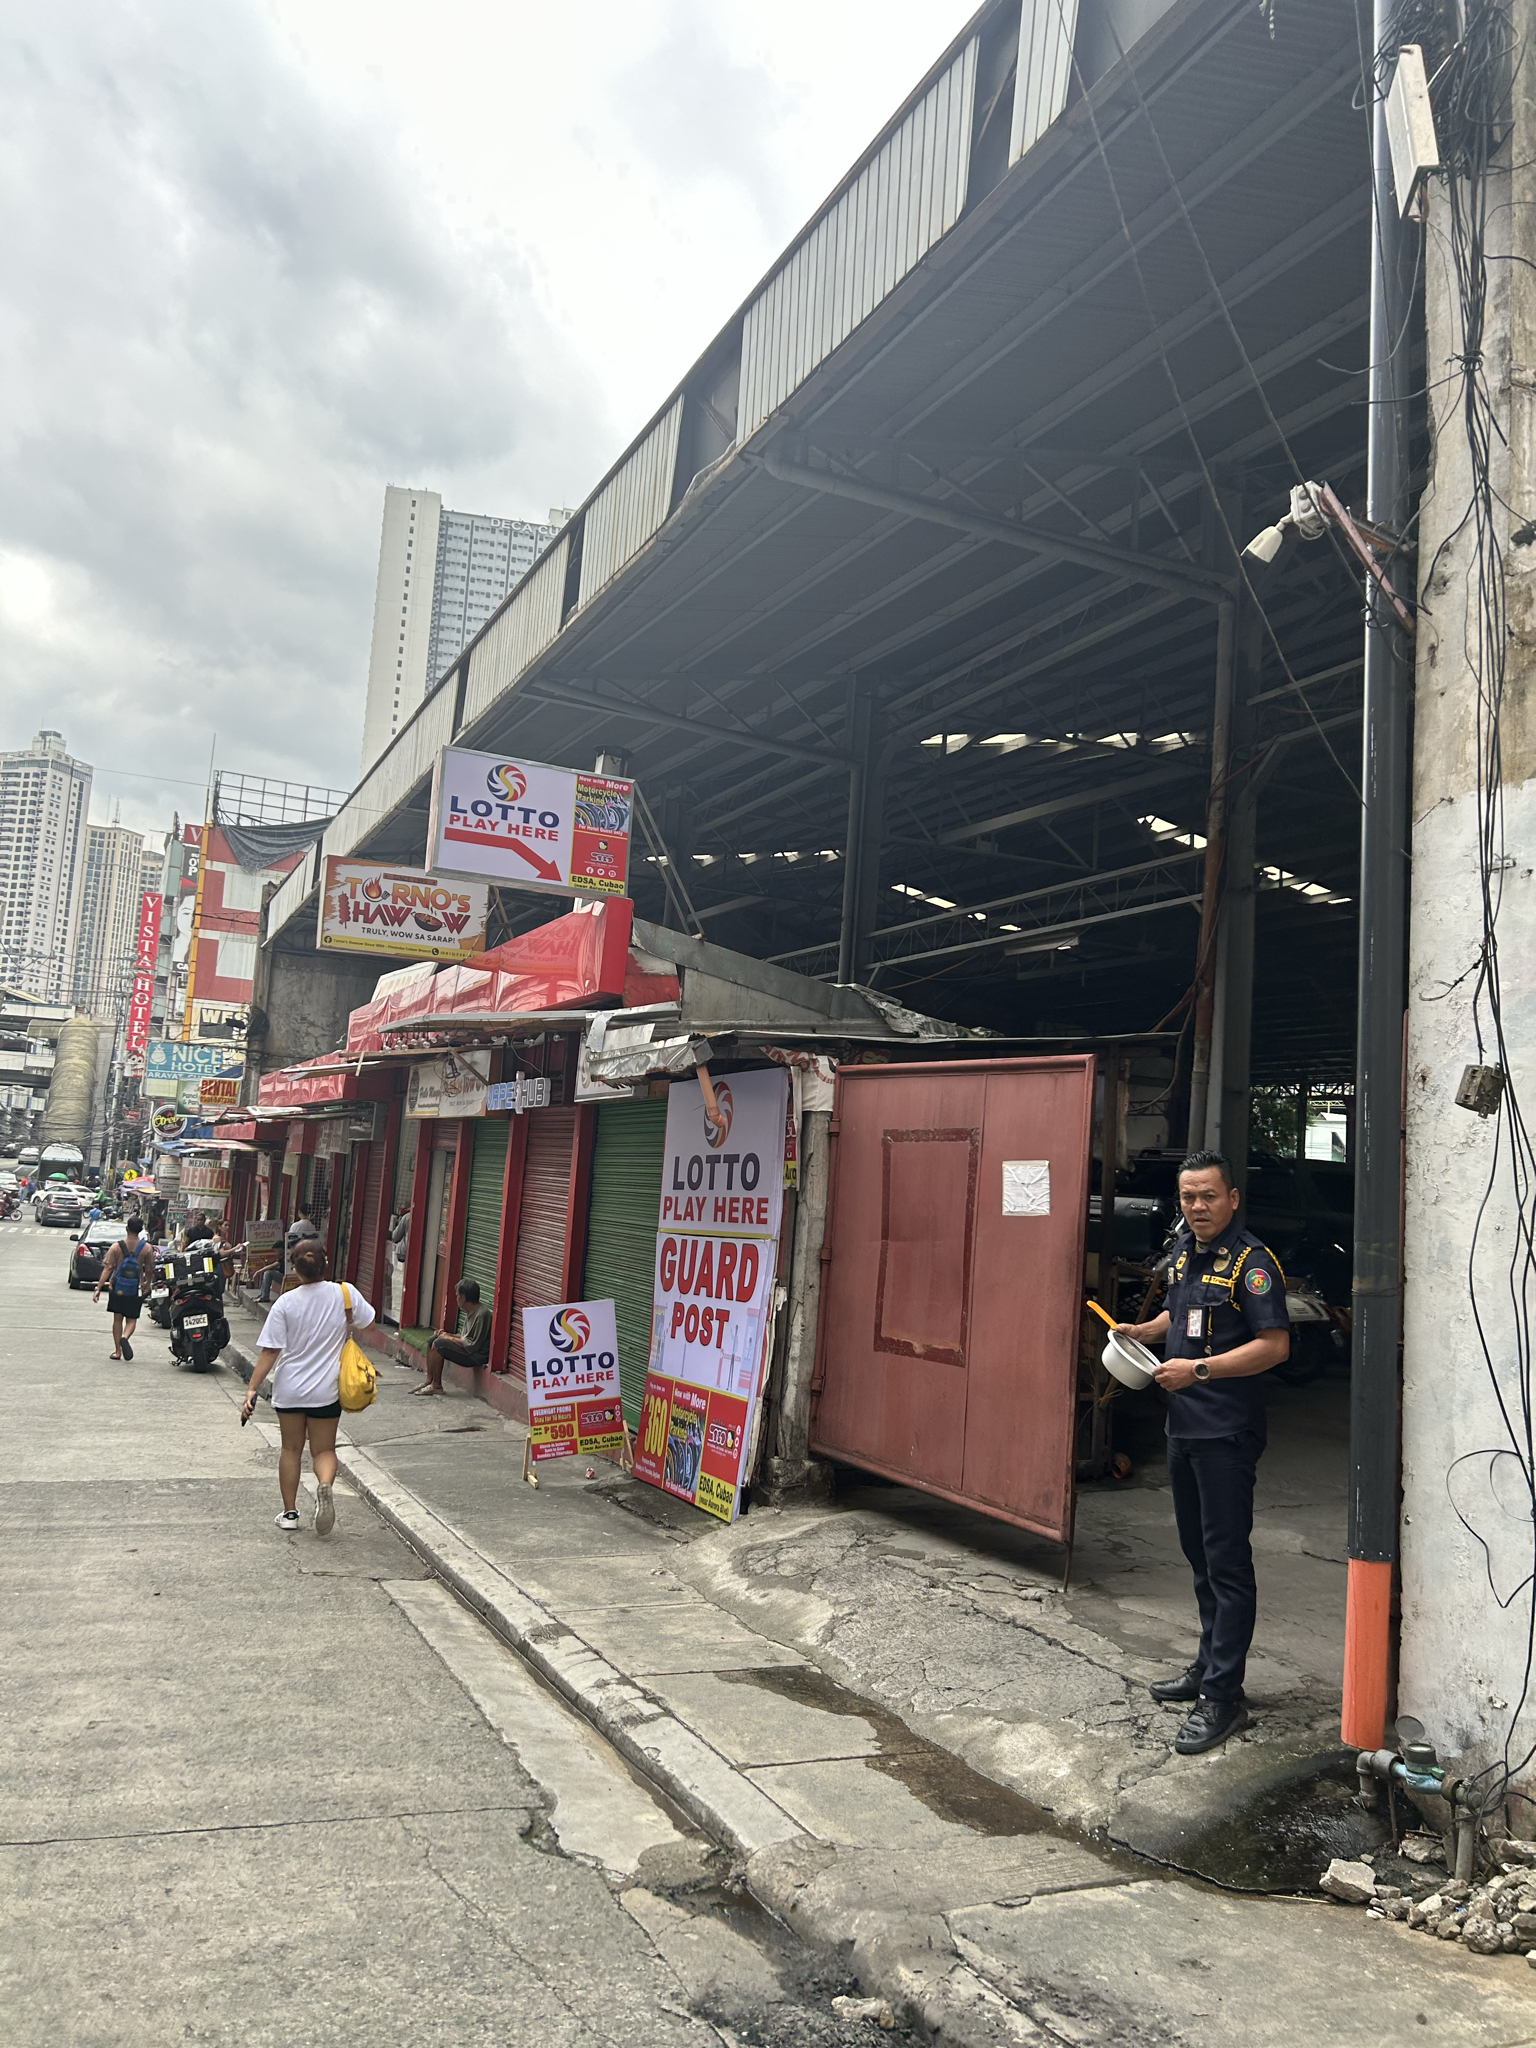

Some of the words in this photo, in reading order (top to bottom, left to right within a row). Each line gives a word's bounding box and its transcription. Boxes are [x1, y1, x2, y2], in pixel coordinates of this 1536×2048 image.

[578, 784, 618, 798] Motorcycle
[606, 780, 628, 791] More
[578, 792, 606, 806] Parking
[450, 796, 560, 828] LOTTO
[449, 814, 500, 832] PLAY
[508, 824, 559, 841] HERE
[572, 876, 596, 886] EDSA,
[598, 880, 624, 890] Cubao
[138, 896, 160, 966] VISTA
[361, 926, 388, 938] TRULY,
[390, 931, 413, 940] WOW
[427, 935, 456, 944] SARAP!
[130, 978, 150, 1048] HOTEL
[171, 1044, 223, 1064] NICE
[171, 1061, 222, 1074] HOTEL
[201, 1080, 237, 1096] DENTAL
[520, 1078, 546, 1107] HUB
[180, 1167, 231, 1189] DENTAL
[672, 1152, 760, 1191] LOTTO
[662, 1196, 707, 1222] PLAY
[713, 1196, 769, 1225] HERE
[660, 1237, 759, 1303] GUARD
[670, 1302, 730, 1349] POST
[531, 1352, 614, 1377] LOTTO
[533, 1376, 569, 1389] PLAY
[576, 1370, 614, 1384] HERE
[691, 1392, 706, 1410] More
[672, 1403, 697, 1424] Motorcycle
[700, 1476, 715, 1498] EDSA,
[716, 1483, 733, 1504] Cubao
[708, 1498, 719, 1512] Aurora
